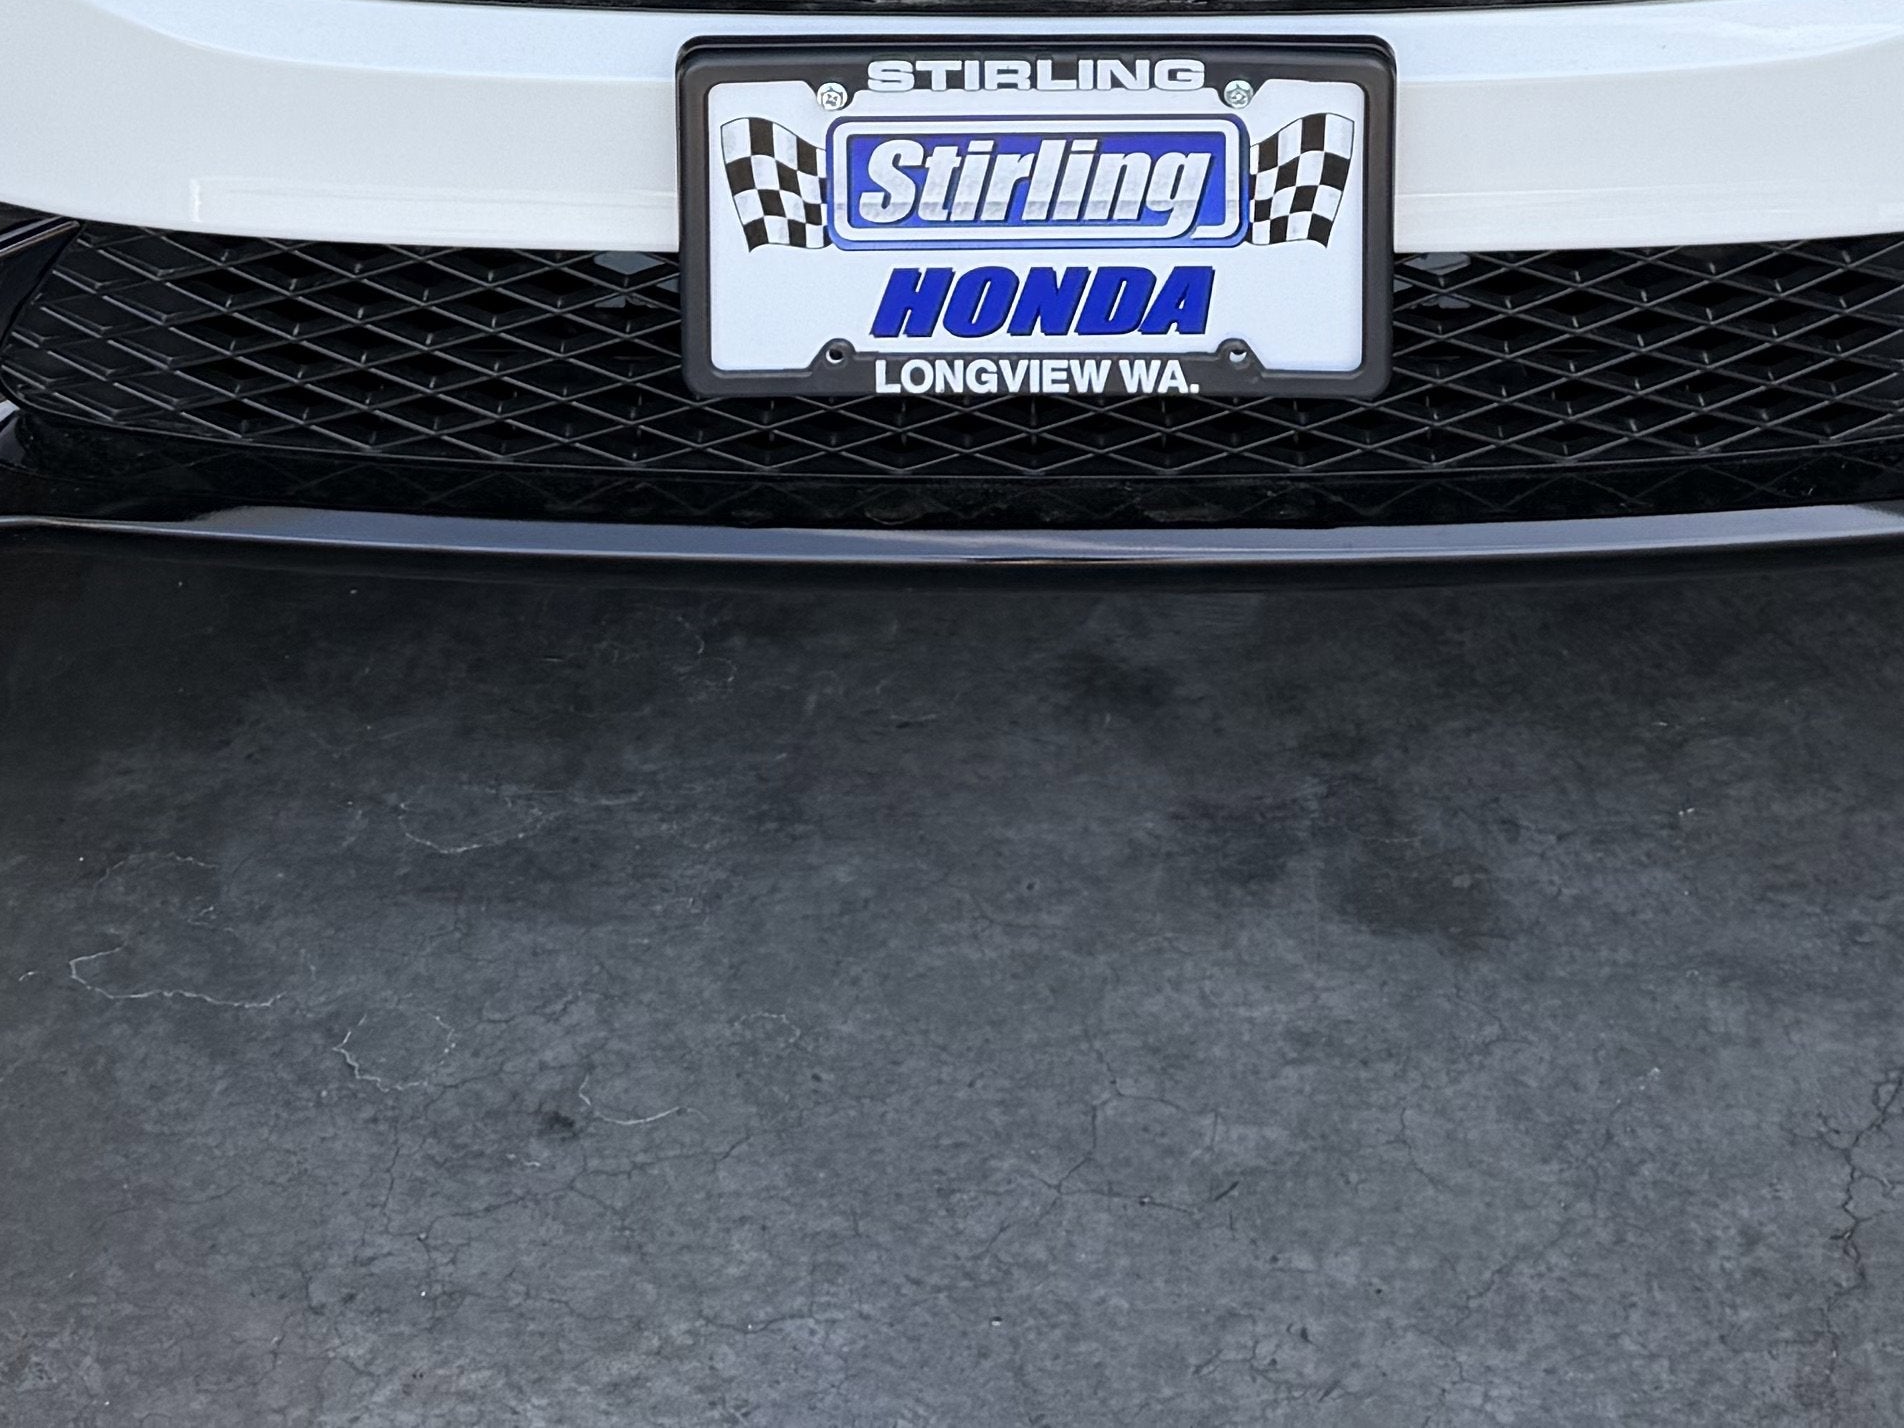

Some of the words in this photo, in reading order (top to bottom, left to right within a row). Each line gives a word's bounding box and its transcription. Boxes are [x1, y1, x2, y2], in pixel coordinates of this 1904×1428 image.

[867, 59, 1206, 92] STIRLING
[857, 139, 1213, 239] Stirling
[869, 265, 1216, 338] HONDA
[875, 360, 1113, 395] LONGVIEW
[1120, 361, 1200, 394] WA.
